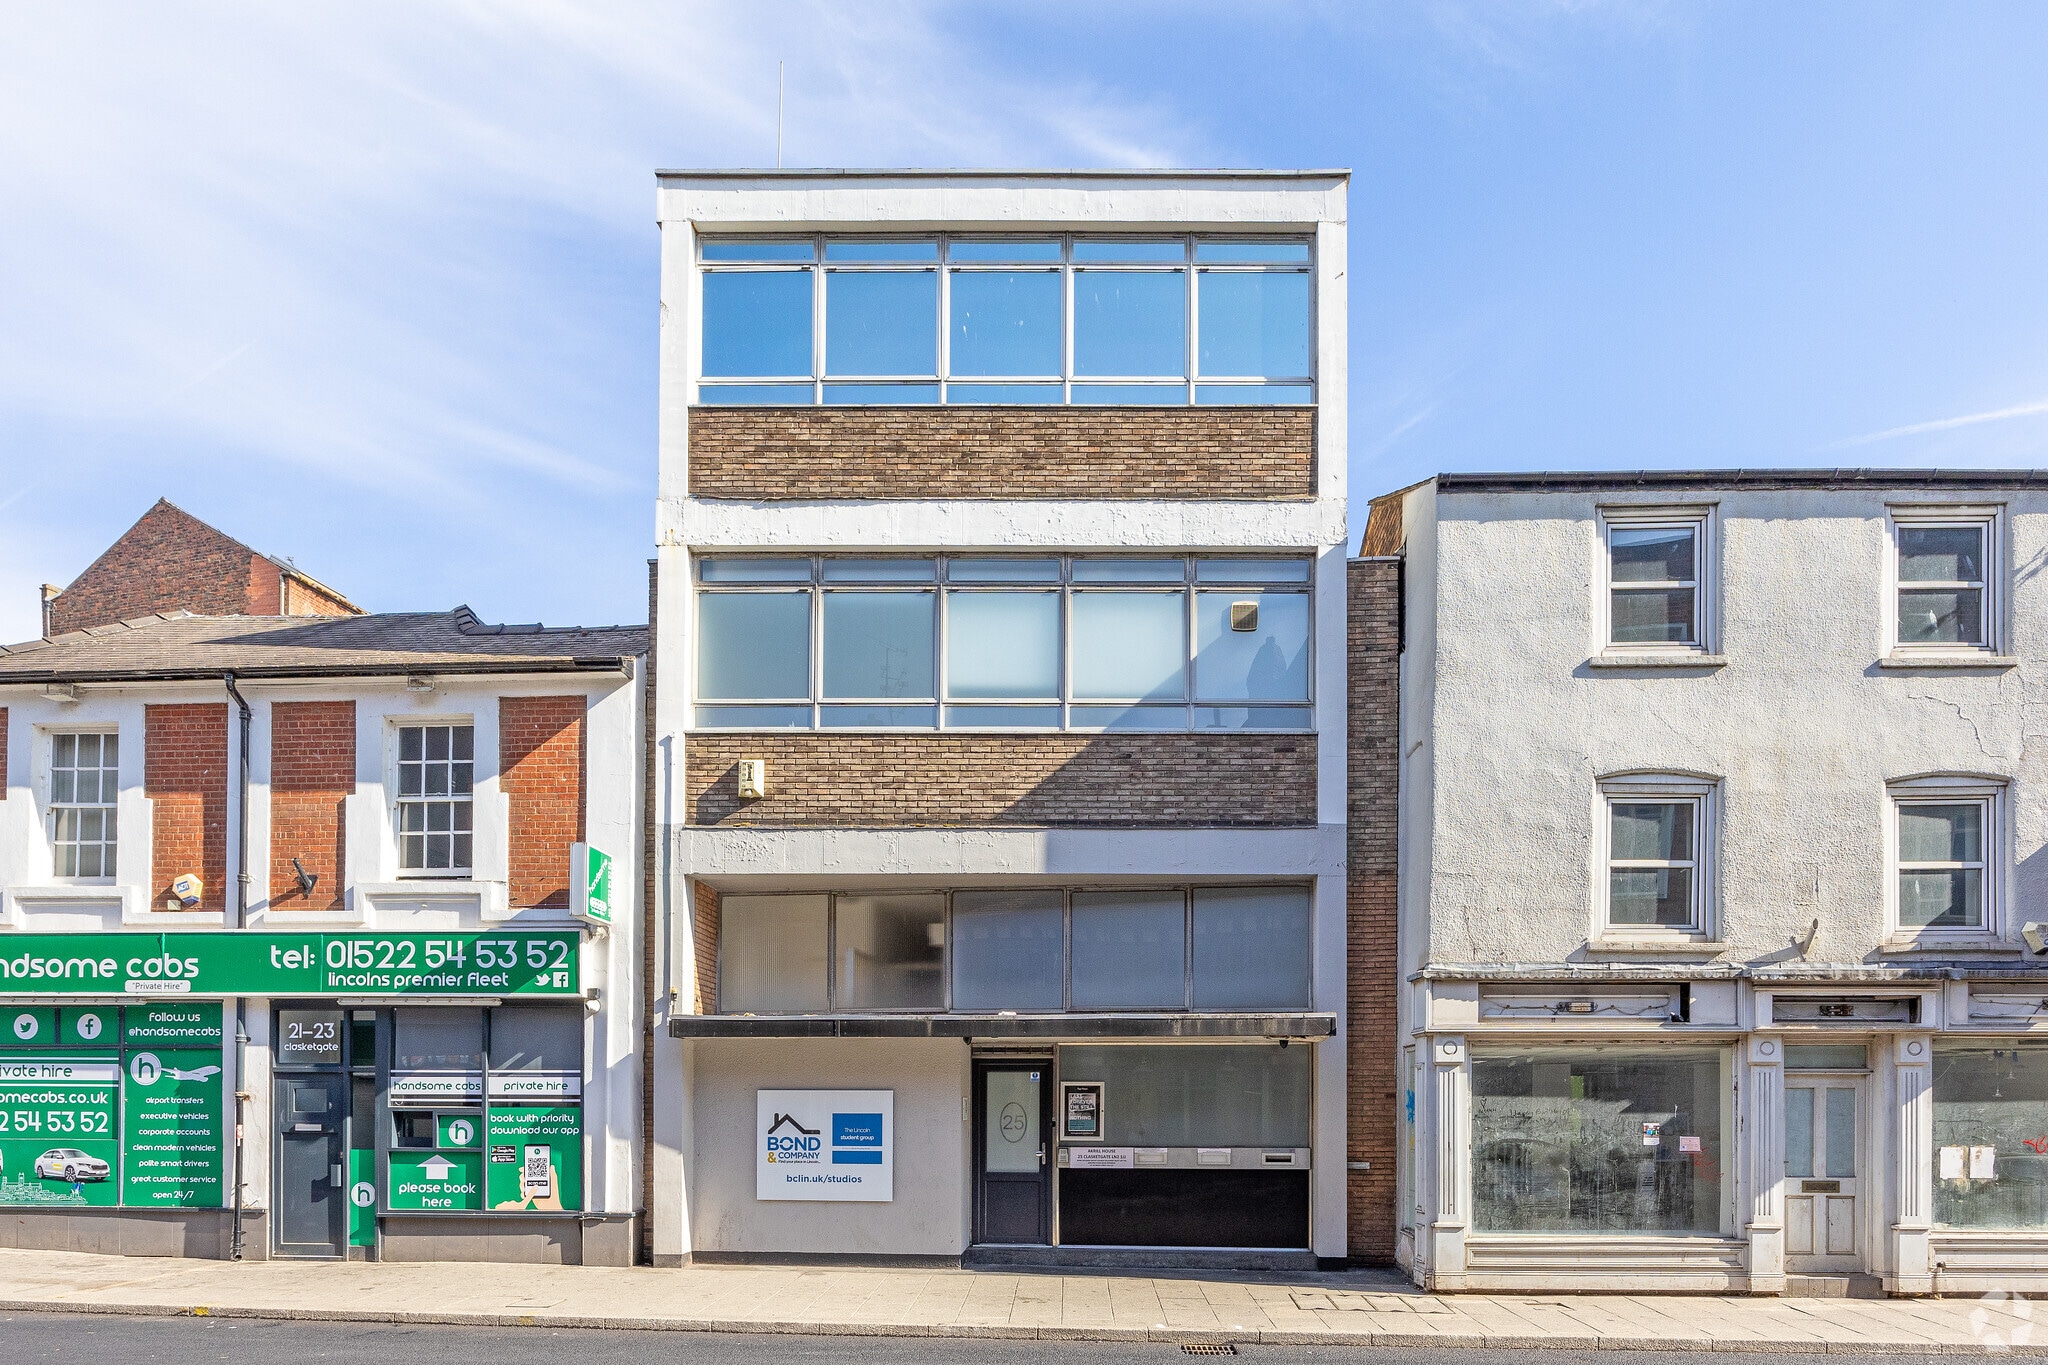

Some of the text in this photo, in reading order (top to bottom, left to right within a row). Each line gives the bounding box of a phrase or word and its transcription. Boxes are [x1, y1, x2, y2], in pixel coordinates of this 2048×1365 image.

[270, 940, 569, 969] tel: 01522 54 53 52
[126, 952, 199, 978] cabs
[328, 971, 509, 990] lincolns premier fleet
[187, 1013, 201, 1022] us
[128, 1026, 222, 1037] @handsomecabs
[288, 1022, 335, 1039] 21-23
[284, 1042, 339, 1054] clasketgate
[41, 1064, 73, 1078] hire
[393, 1081, 481, 1091] handsome cabs
[503, 1081, 569, 1092] private hire
[145, 1096, 204, 1105] airport transfers
[14, 1110, 42, 1132] 54
[47, 1111, 76, 1133] 53
[80, 1111, 109, 1133] 52
[140, 1112, 209, 1120] executive vehicles
[490, 1113, 575, 1125] book with priority
[1003, 1115, 1024, 1130] 25
[138, 1128, 211, 1137] corporate accounts
[490, 1125, 580, 1136] download our app
[132, 1144, 217, 1152] clean modern vehicles
[767, 1136, 821, 1152] BOND
[767, 1151, 821, 1164] & COMPANY
[138, 1160, 210, 1168] polite smart drivers
[131, 1176, 217, 1184] great customer service
[786, 1174, 862, 1184] bclin.uk/studios
[399, 1181, 476, 1195] please book
[152, 1190, 195, 1201] open 24/7
[422, 1196, 452, 1207] here
